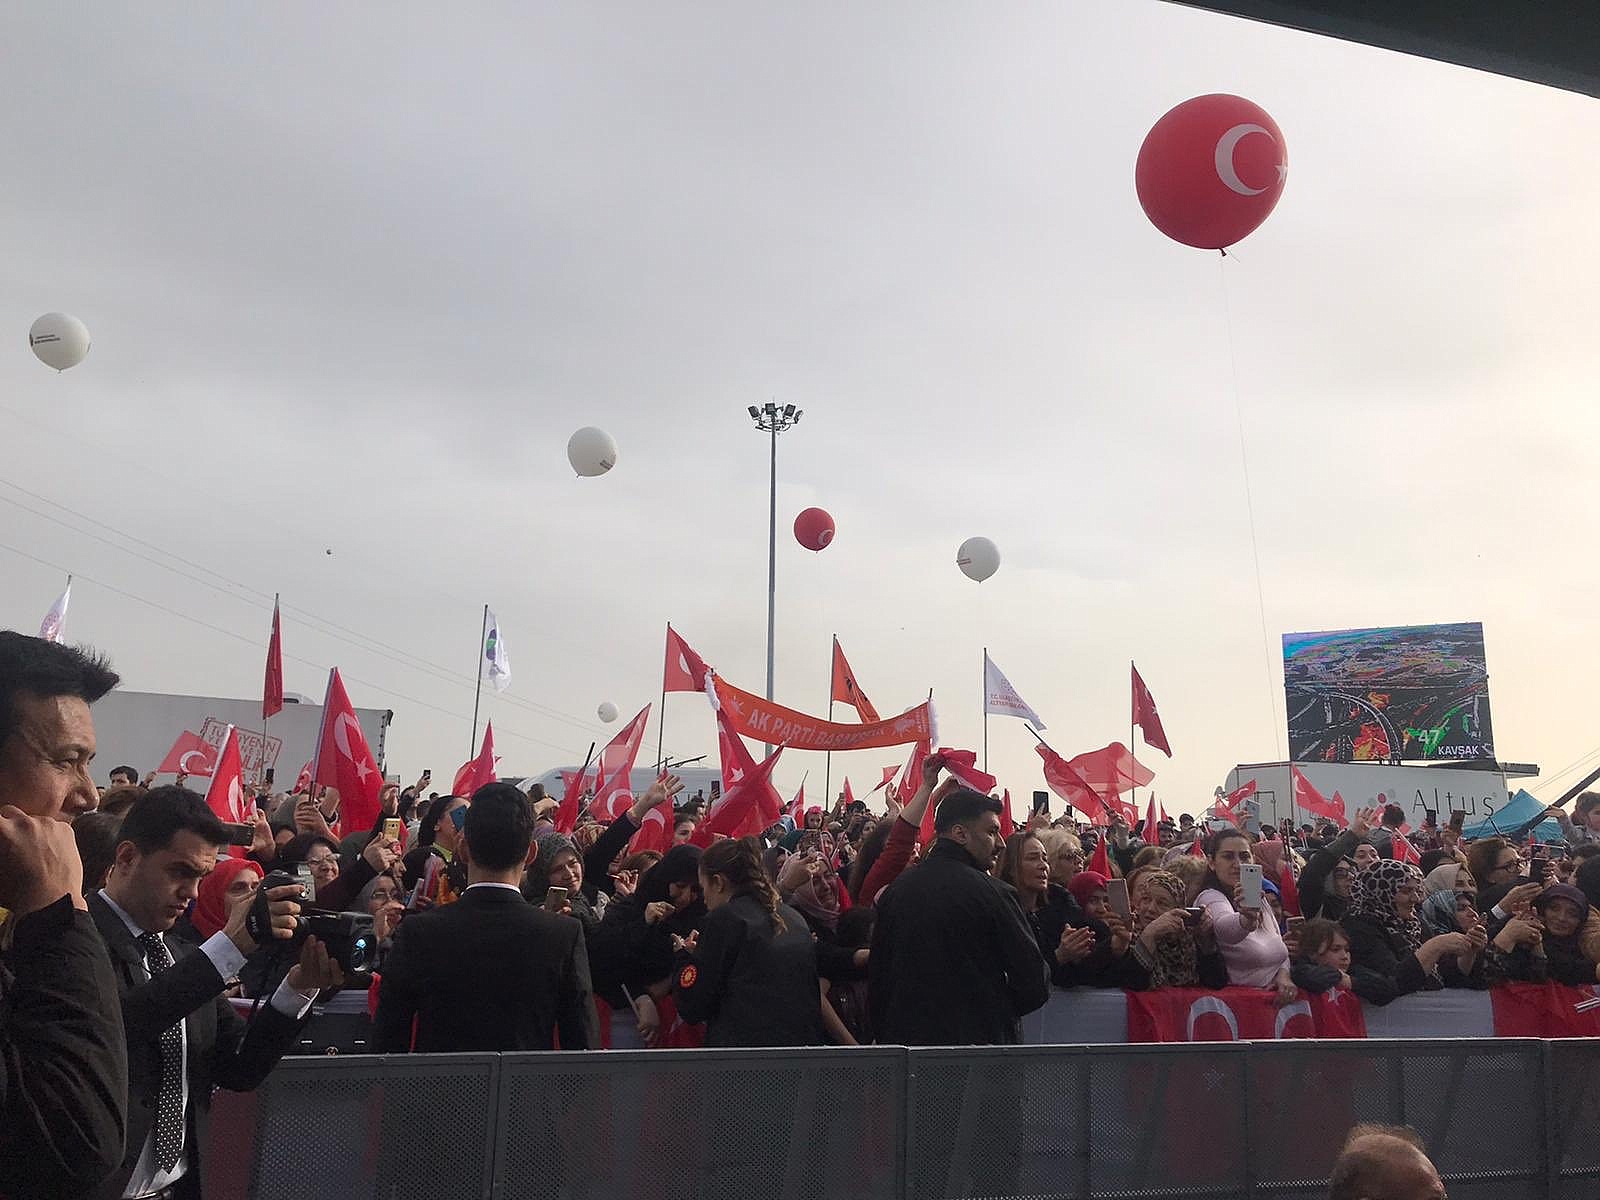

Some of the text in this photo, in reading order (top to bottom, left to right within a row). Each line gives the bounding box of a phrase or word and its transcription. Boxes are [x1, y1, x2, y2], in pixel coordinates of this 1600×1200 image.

[746, 708, 770, 732] AK
[1418, 729, 1441, 745] 47
[1412, 787, 1494, 818] Altus
